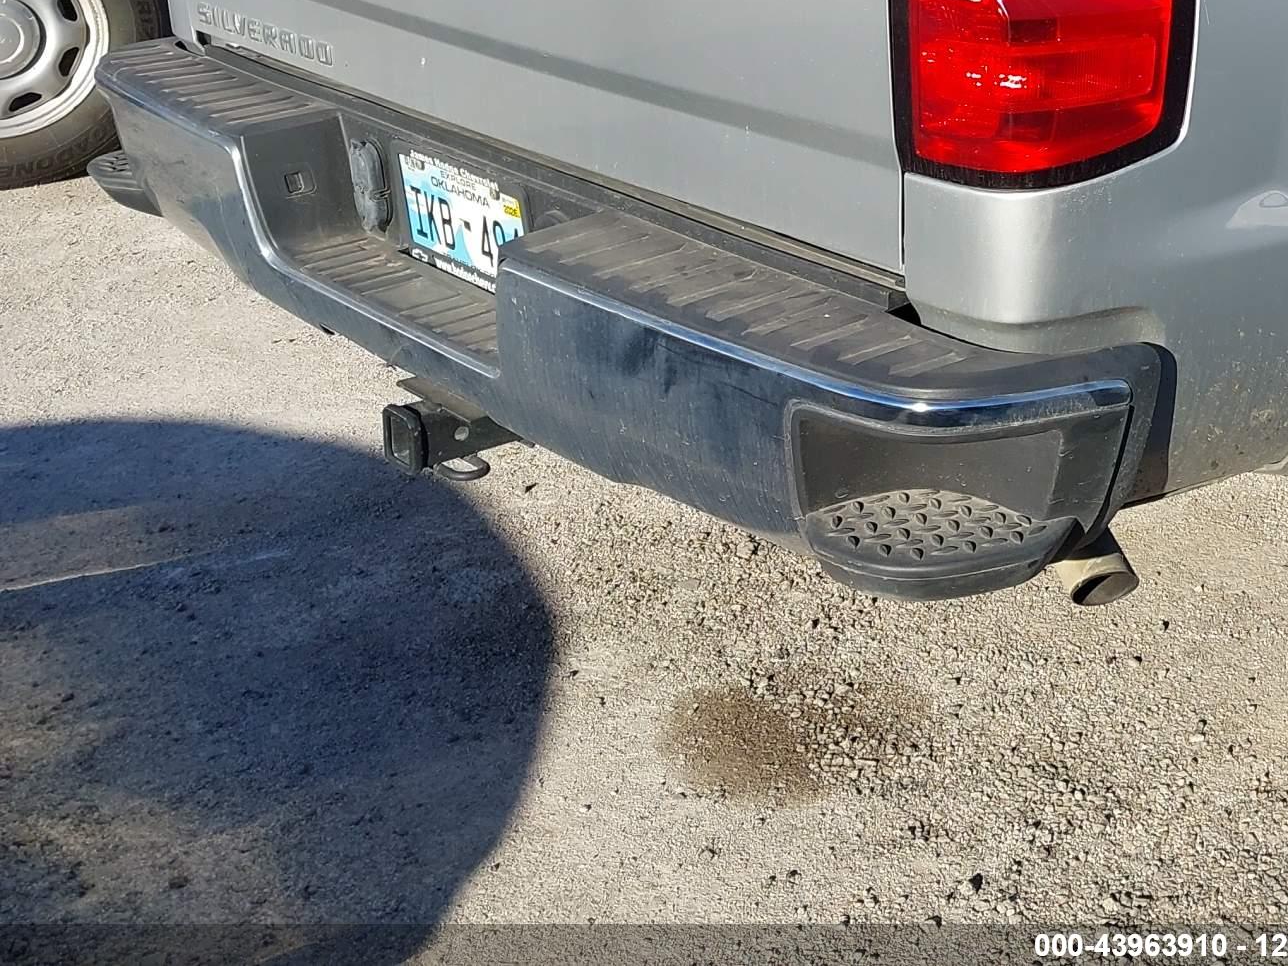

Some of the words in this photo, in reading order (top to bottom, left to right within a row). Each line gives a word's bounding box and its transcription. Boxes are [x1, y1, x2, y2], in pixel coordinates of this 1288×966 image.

[197, 2, 334, 67] SILVERADO
[431, 176, 490, 208] OKLAHOMA
[440, 171, 477, 191] EXPLORE
